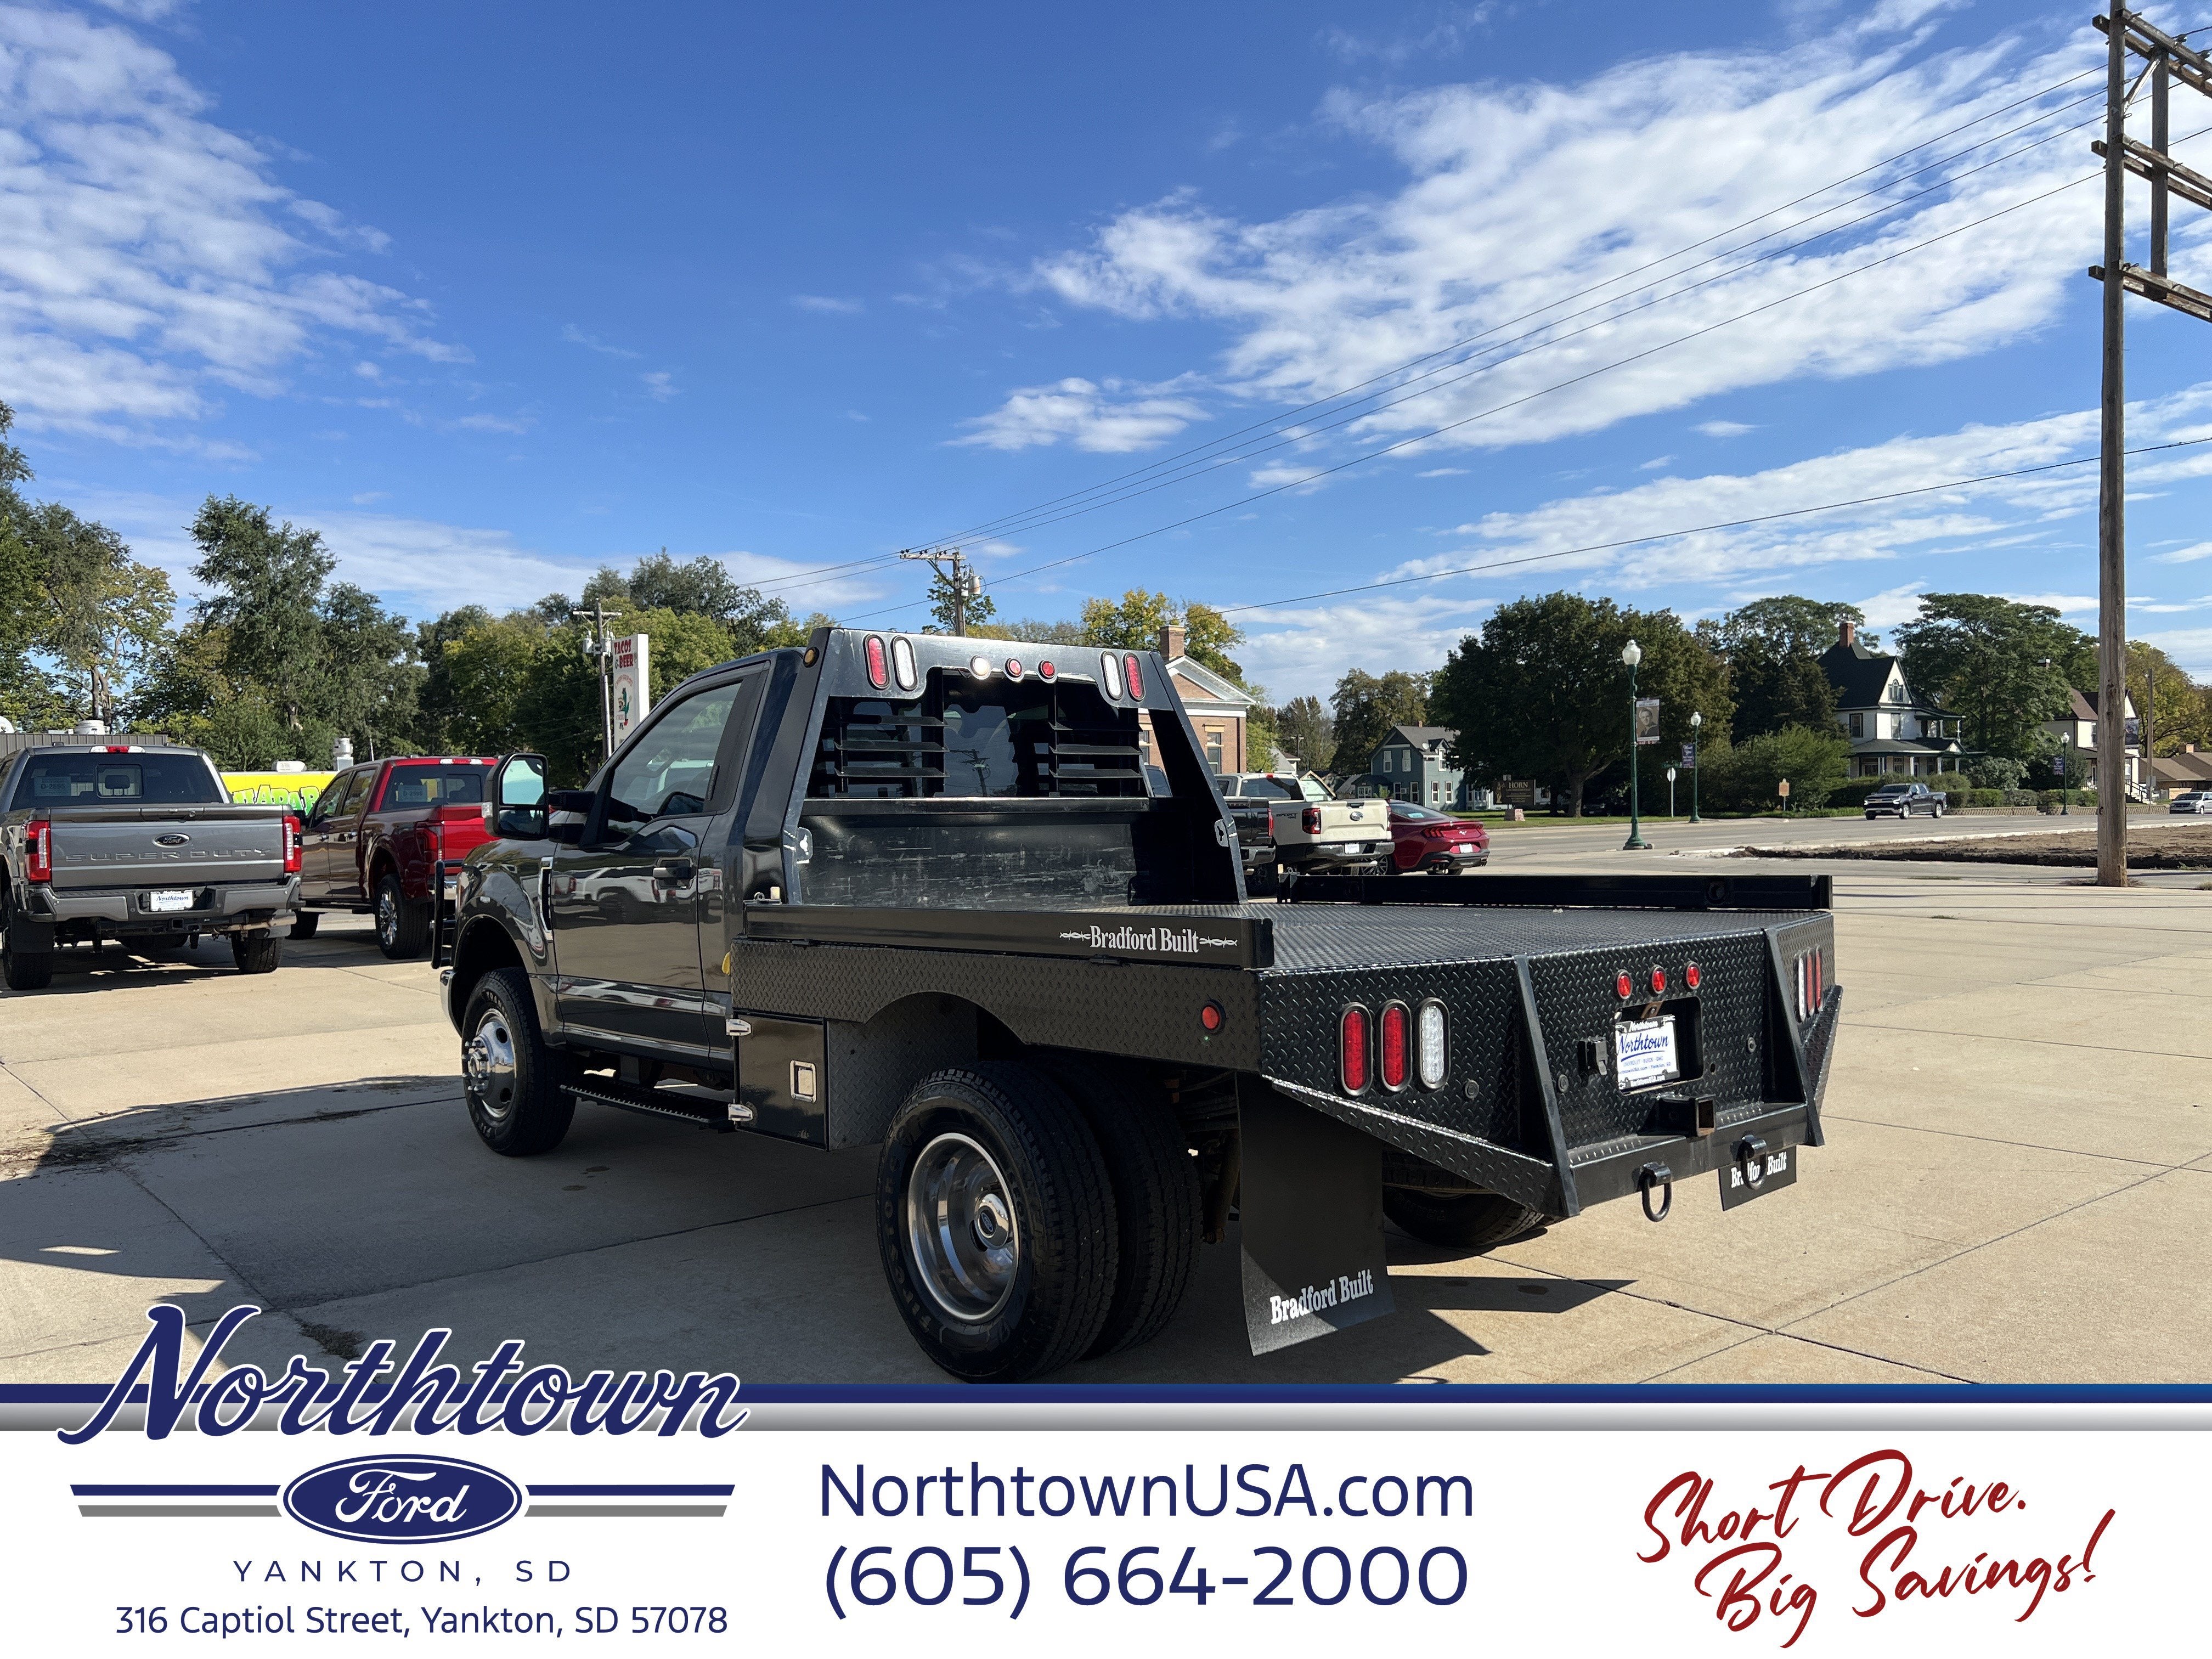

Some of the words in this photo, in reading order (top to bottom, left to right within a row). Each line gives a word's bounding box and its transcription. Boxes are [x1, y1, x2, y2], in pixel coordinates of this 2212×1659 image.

[613, 639, 632, 655] TACOS
[619, 653, 634, 669] BEER
[163, 836, 182, 844] Ford
[66, 852, 181, 862] SUPER
[190, 849, 271, 858] DUTY
[1090, 925, 1156, 951] Bradford
[1159, 928, 1199, 953] Built
[1617, 1032, 1668, 1054] Northtown
[1767, 1152, 1787, 1175] Built
[1269, 1279, 1338, 1324] Bradford
[1339, 1269, 1373, 1303] Built
